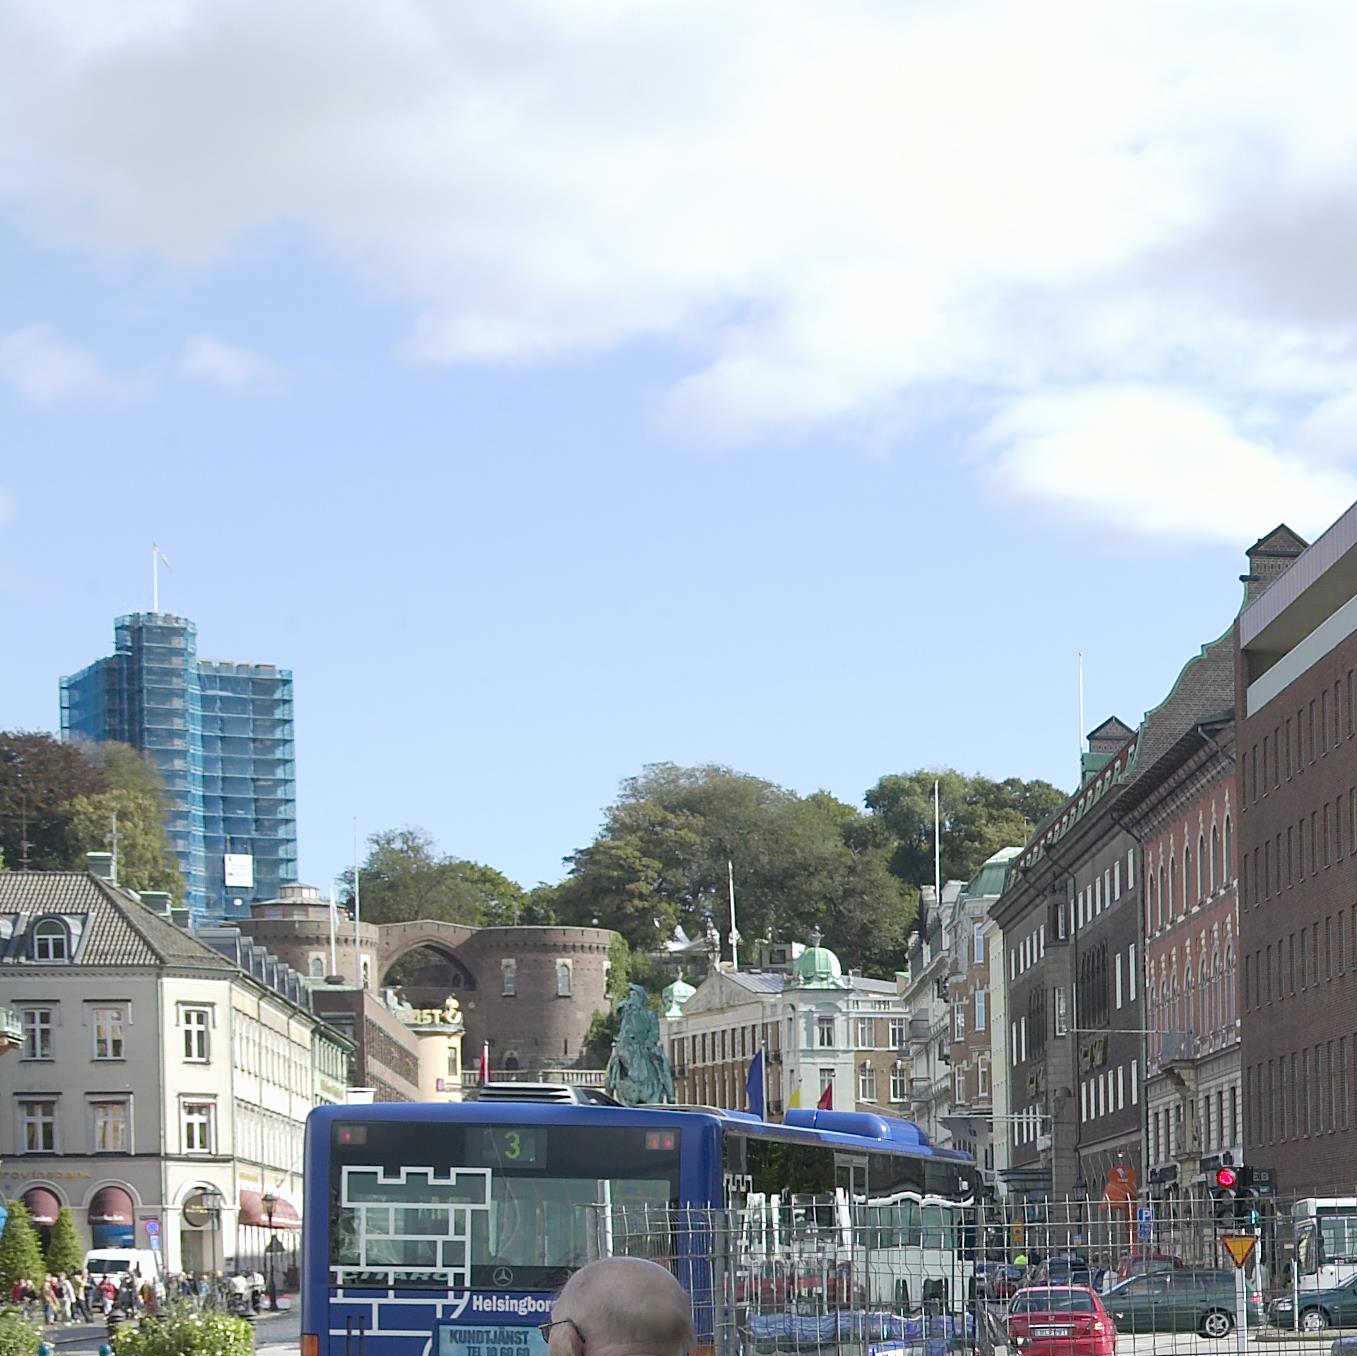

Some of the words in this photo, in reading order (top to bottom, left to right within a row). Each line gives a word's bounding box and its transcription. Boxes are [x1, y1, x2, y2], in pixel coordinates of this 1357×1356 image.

[504, 1131, 520, 1159] 3
[472, 1295, 551, 1315] Helsingbor
[449, 1327, 529, 1345] KUNDTJÄNST
